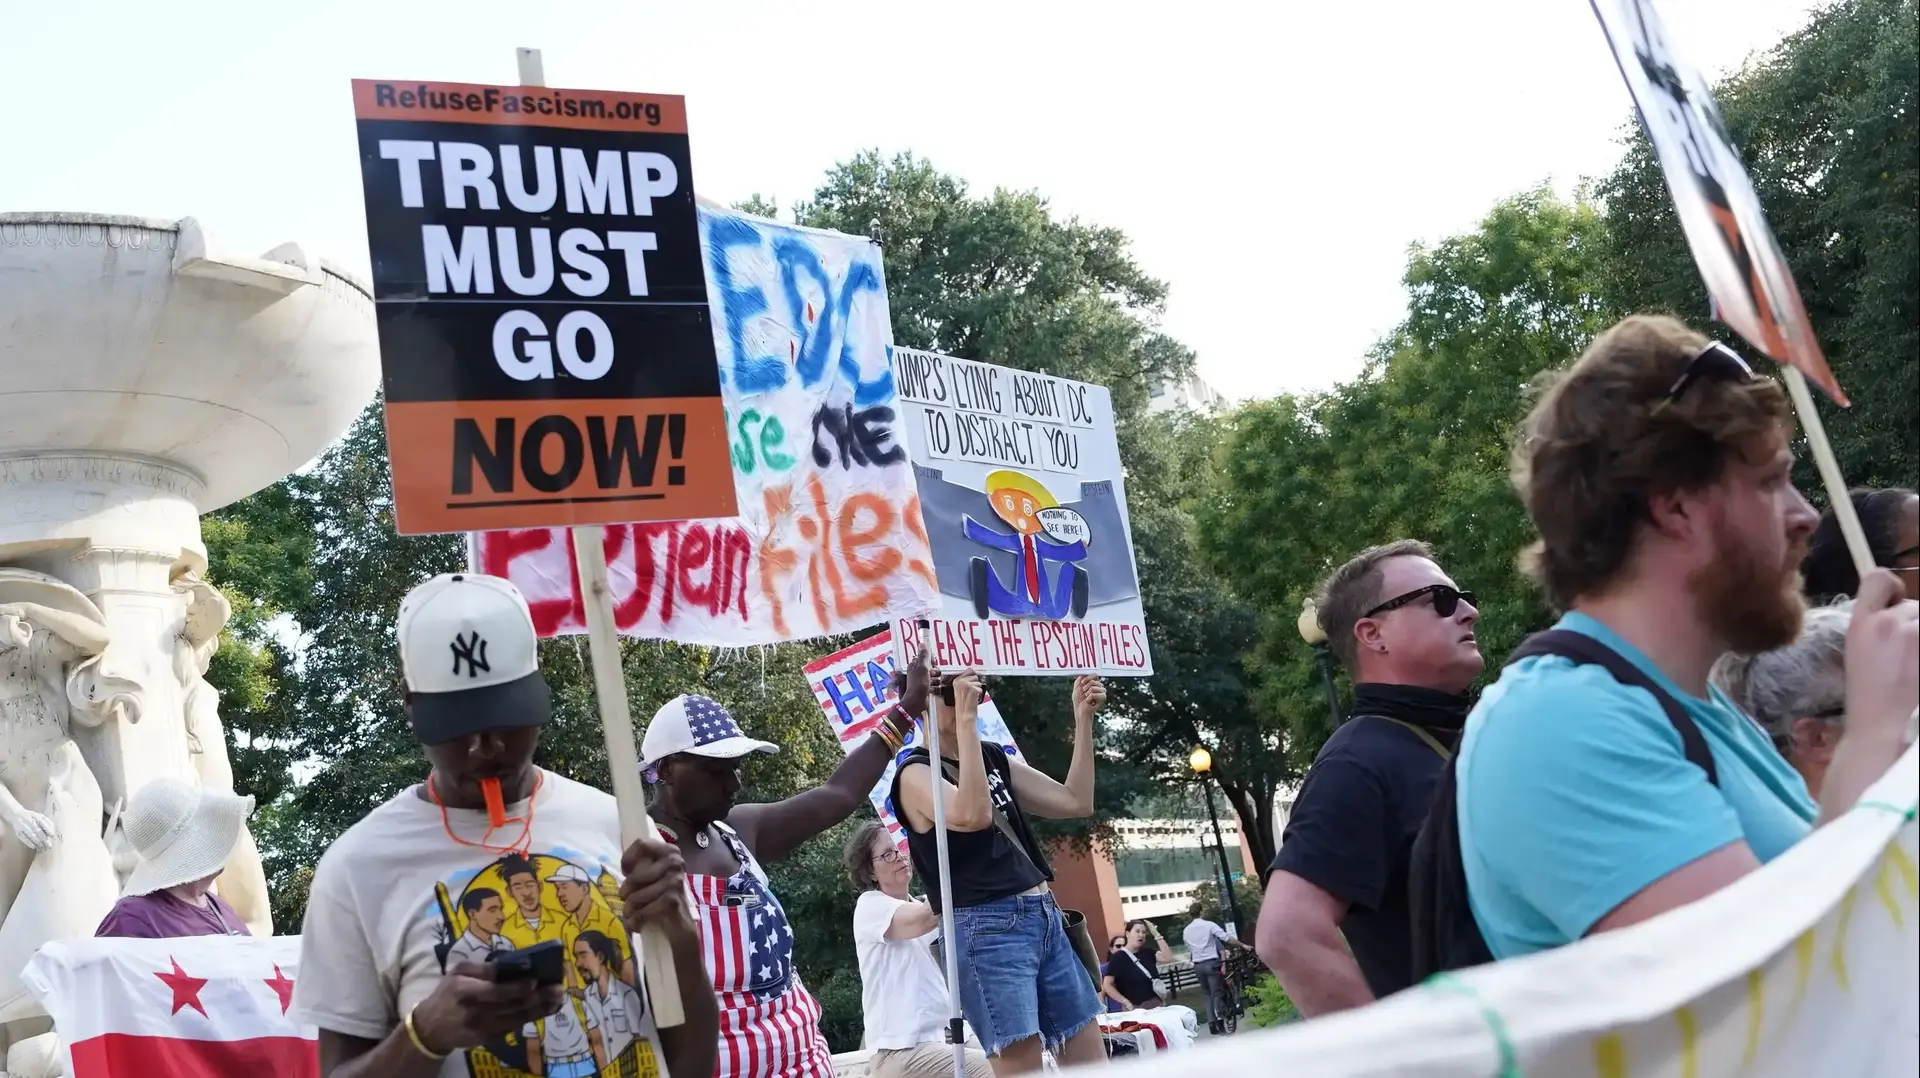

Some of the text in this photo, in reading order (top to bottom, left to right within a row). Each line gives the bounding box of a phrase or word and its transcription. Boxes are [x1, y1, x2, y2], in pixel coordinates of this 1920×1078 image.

[375, 83, 661, 125] RefuseFascism.org
[378, 139, 679, 216] TRUMP
[421, 224, 659, 297] MUST
[492, 309, 615, 381] GO
[896, 352, 1092, 424] UMP'S LYING ABOUT DC
[451, 413, 687, 496] NOW!
[924, 408, 1079, 470] TO DISTRACT YOU
[1041, 510, 1079, 522] NOTHING TO
[1046, 522, 1083, 537] SEE HERE!
[899, 617, 1146, 669] REASE THE EPSTEIN FILES
[821, 656, 896, 725] HA
